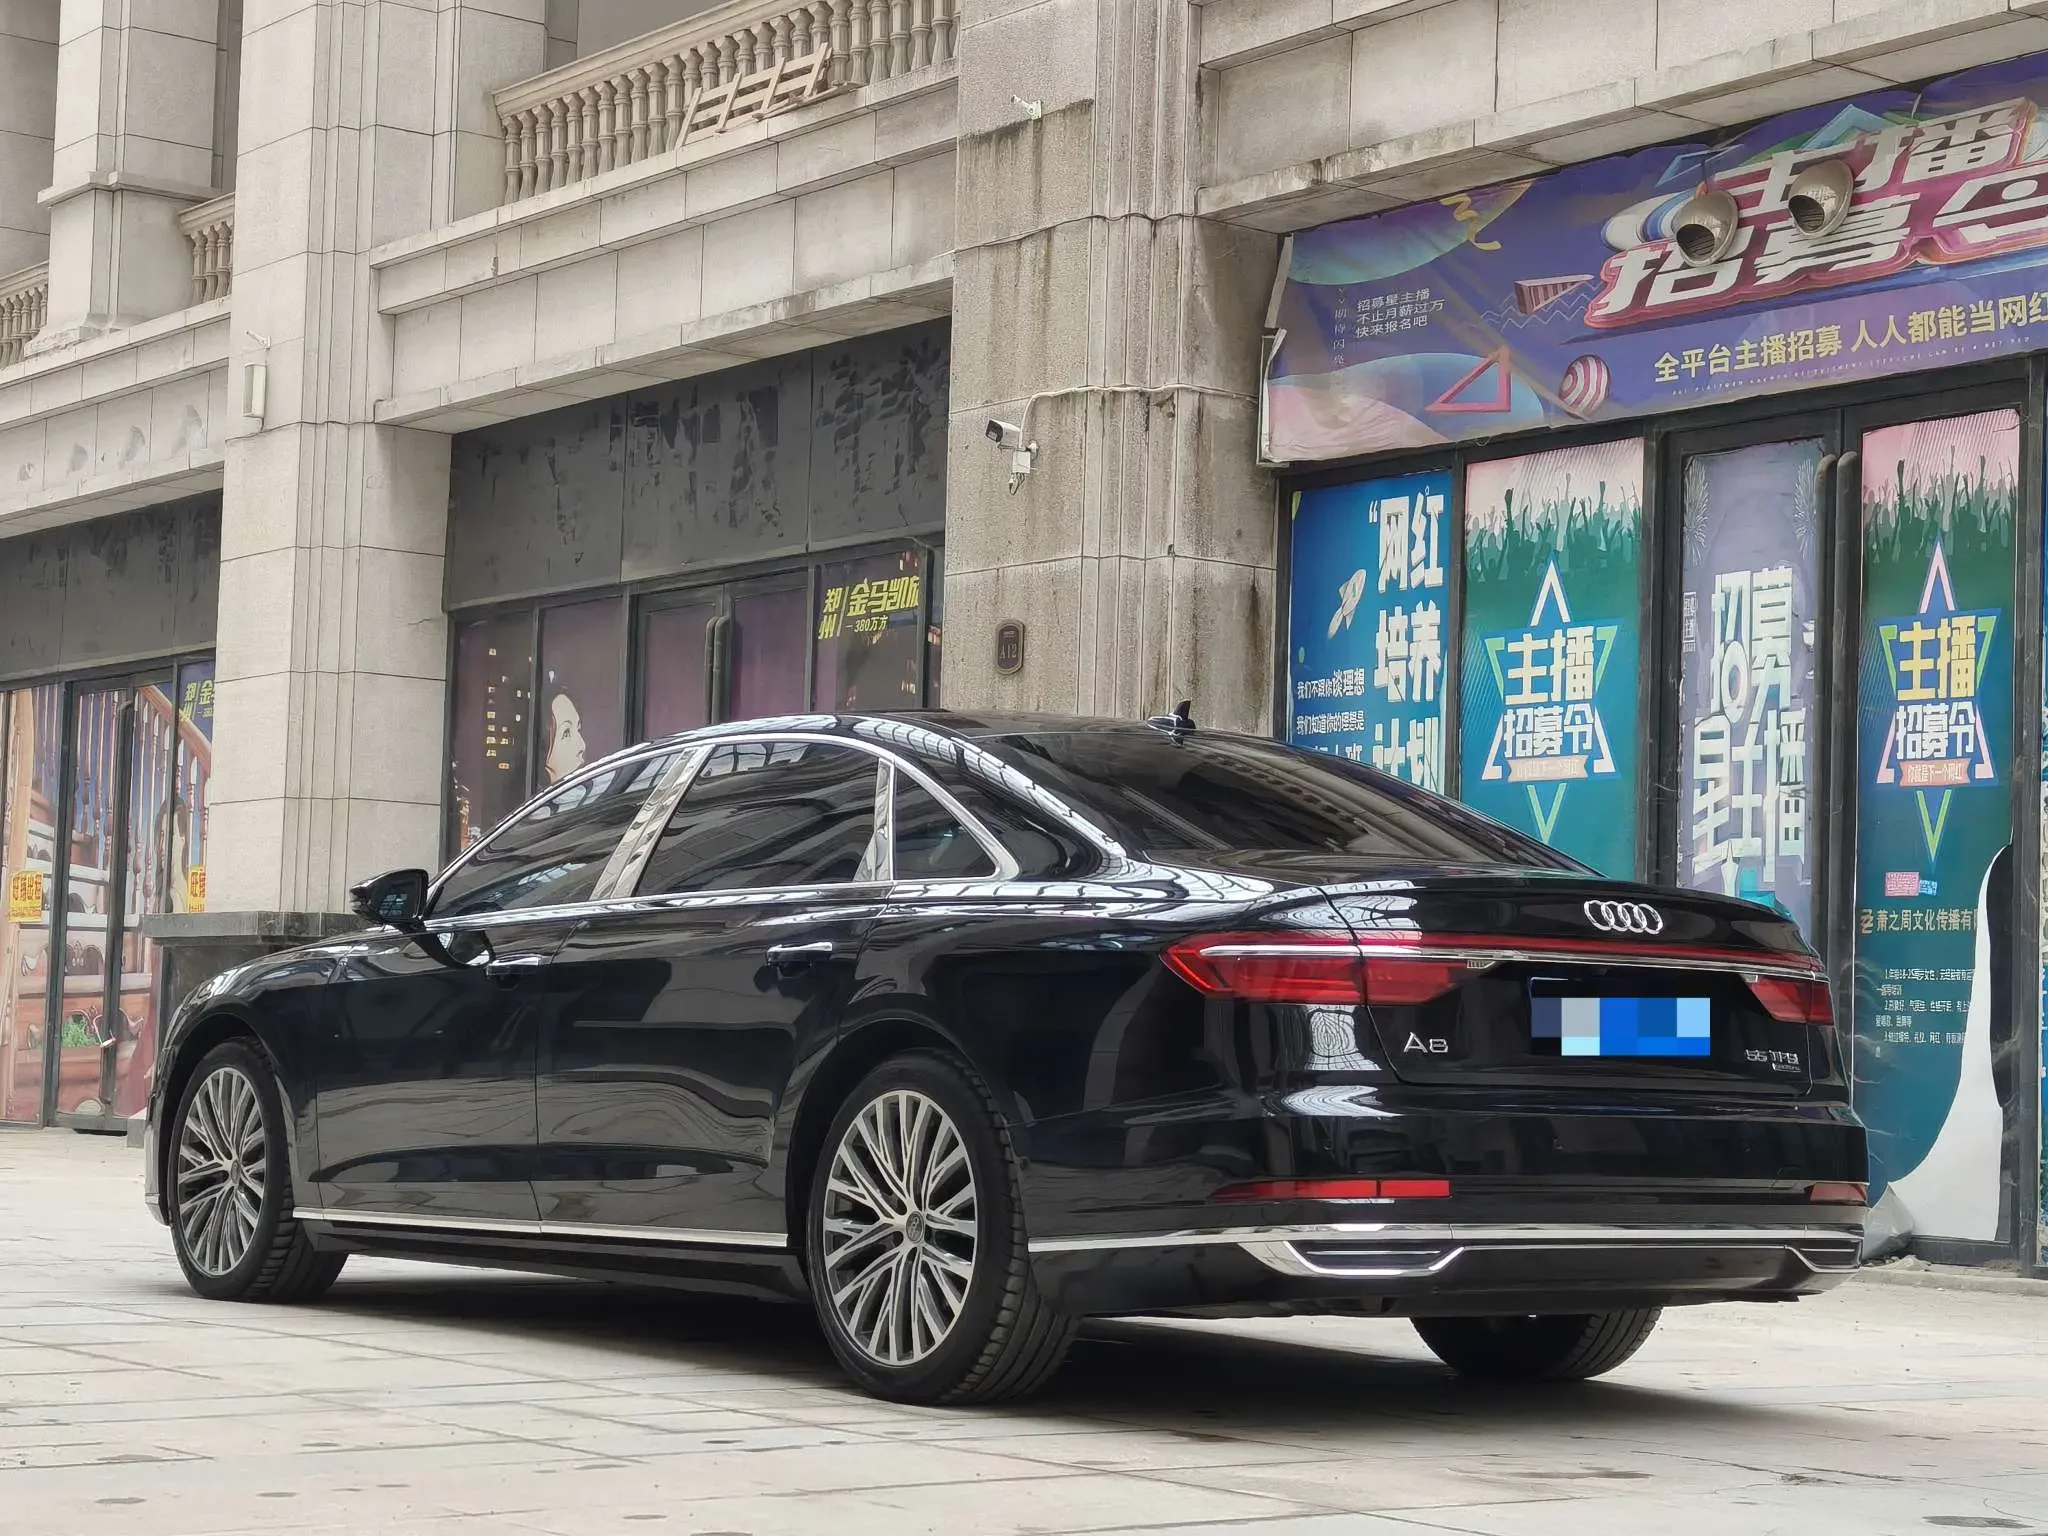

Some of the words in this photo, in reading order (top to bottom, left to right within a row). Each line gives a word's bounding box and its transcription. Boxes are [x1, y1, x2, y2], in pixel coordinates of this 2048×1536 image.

[1355, 315, 1428, 339] 快来报名吧
[1654, 325, 1843, 383] 全平台主播招募
[1851, 292, 2048, 353] 人人都能当网红
[1373, 600, 1442, 703] 培养
[1505, 625, 1595, 706] 主播
[1898, 615, 1976, 702] 主播
[1504, 703, 1595, 758] 招募令
[1896, 701, 1976, 760] 招募令
[1403, 1031, 1449, 1053] A8
